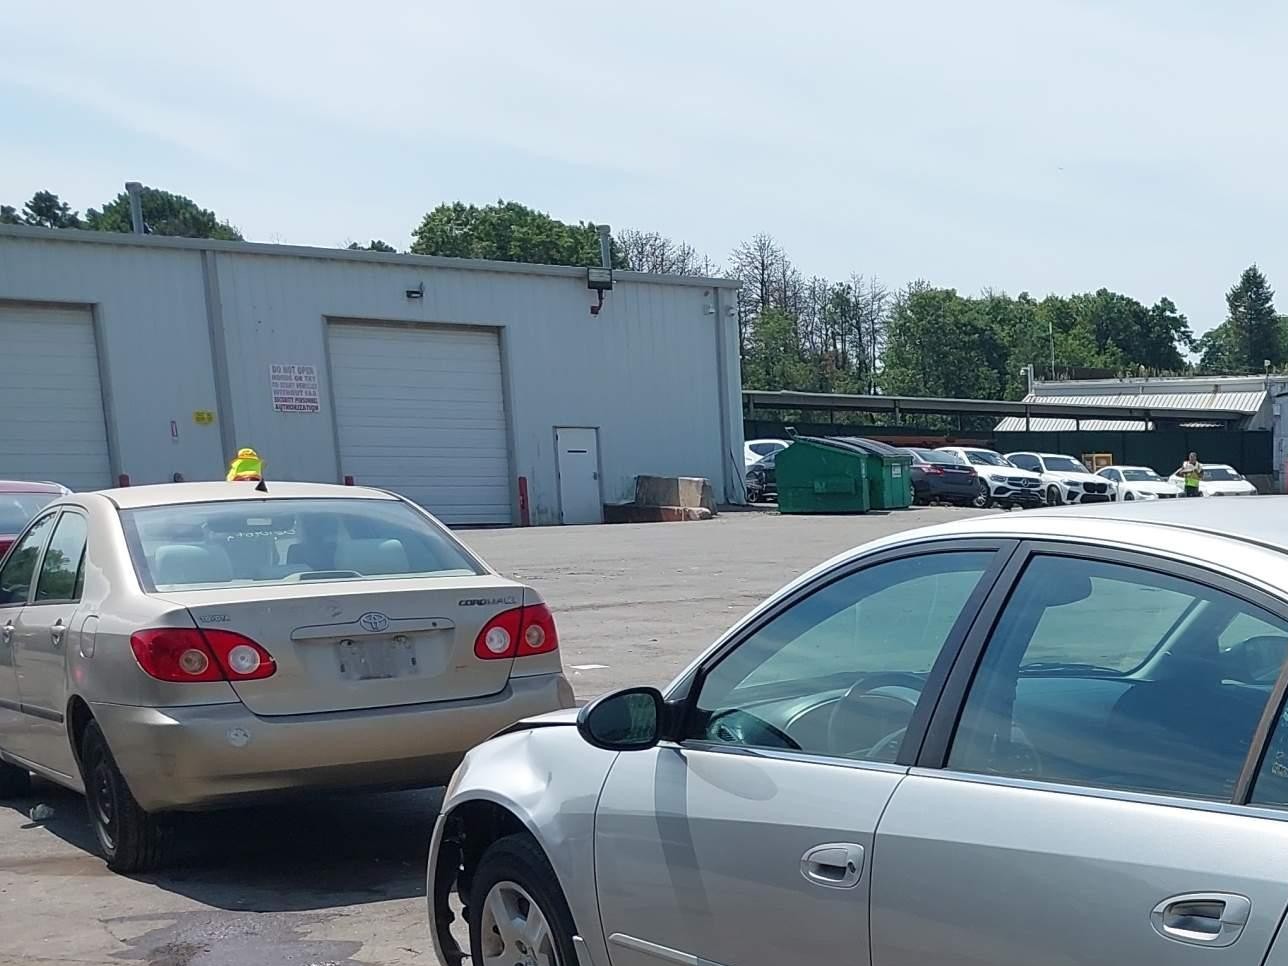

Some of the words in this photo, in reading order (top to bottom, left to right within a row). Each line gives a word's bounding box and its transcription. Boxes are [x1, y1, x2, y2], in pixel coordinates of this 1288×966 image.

[272, 365, 281, 374] DO
[283, 365, 295, 375] NOT
[297, 366, 314, 375] OPEN
